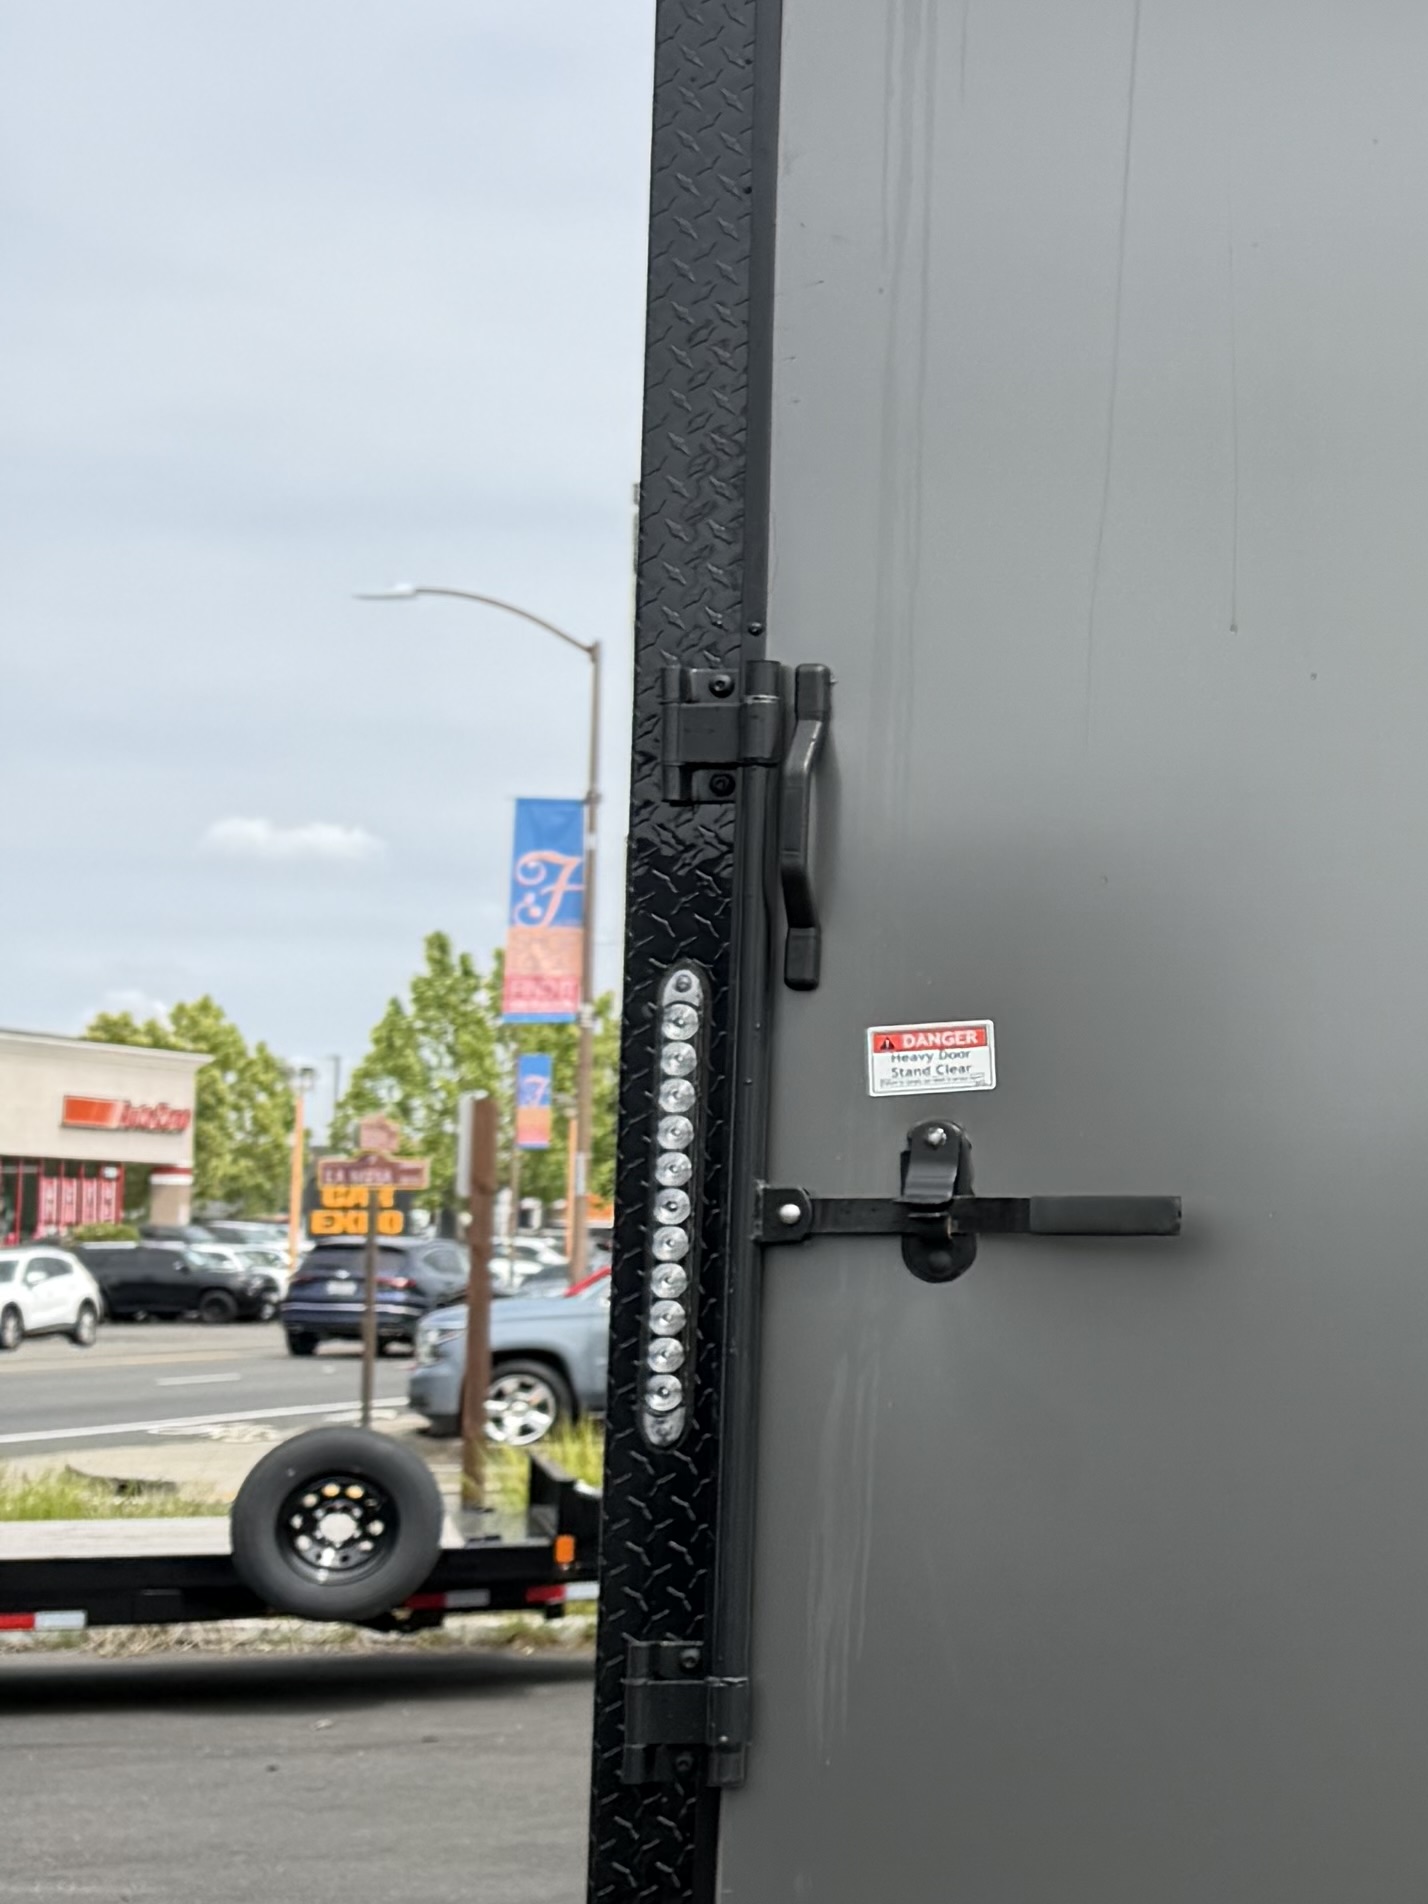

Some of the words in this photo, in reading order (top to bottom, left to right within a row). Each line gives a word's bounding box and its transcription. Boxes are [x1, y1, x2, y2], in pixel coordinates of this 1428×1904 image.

[903, 1031, 978, 1048] DANGER
[891, 1052, 933, 1063] Heavy
[938, 1050, 972, 1060] Door
[891, 1066, 931, 1079] Stand
[936, 1063, 973, 1076] Clear
